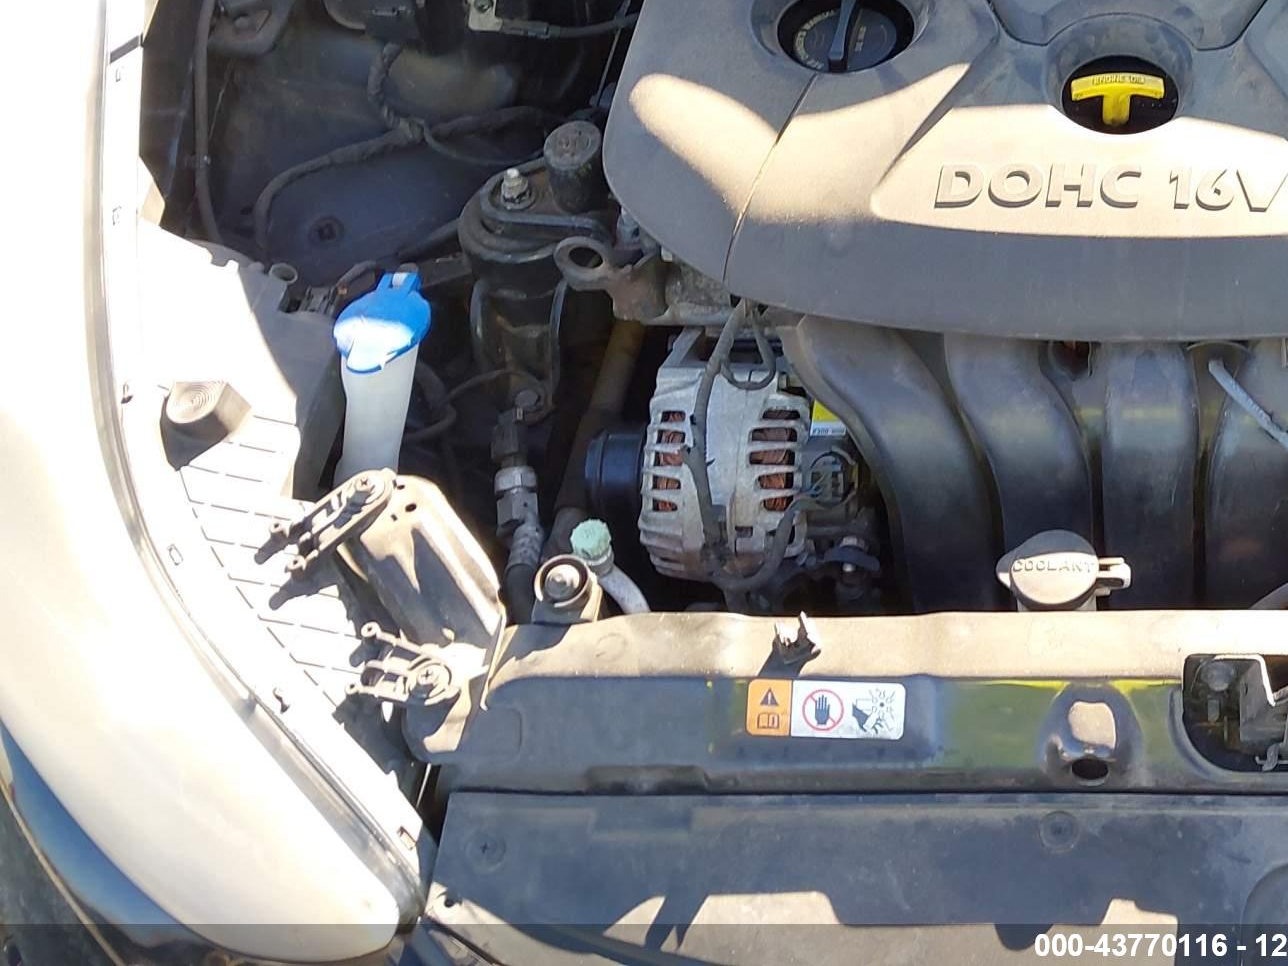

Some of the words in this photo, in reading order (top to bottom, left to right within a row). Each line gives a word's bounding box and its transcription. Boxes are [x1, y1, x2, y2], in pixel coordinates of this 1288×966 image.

[1092, 75, 1126, 85] ENGINE
[1129, 74, 1145, 84] OIL
[934, 164, 1142, 209] DOHC
[1169, 166, 1288, 213] 16V
[1012, 558, 1095, 573] COOLANT
